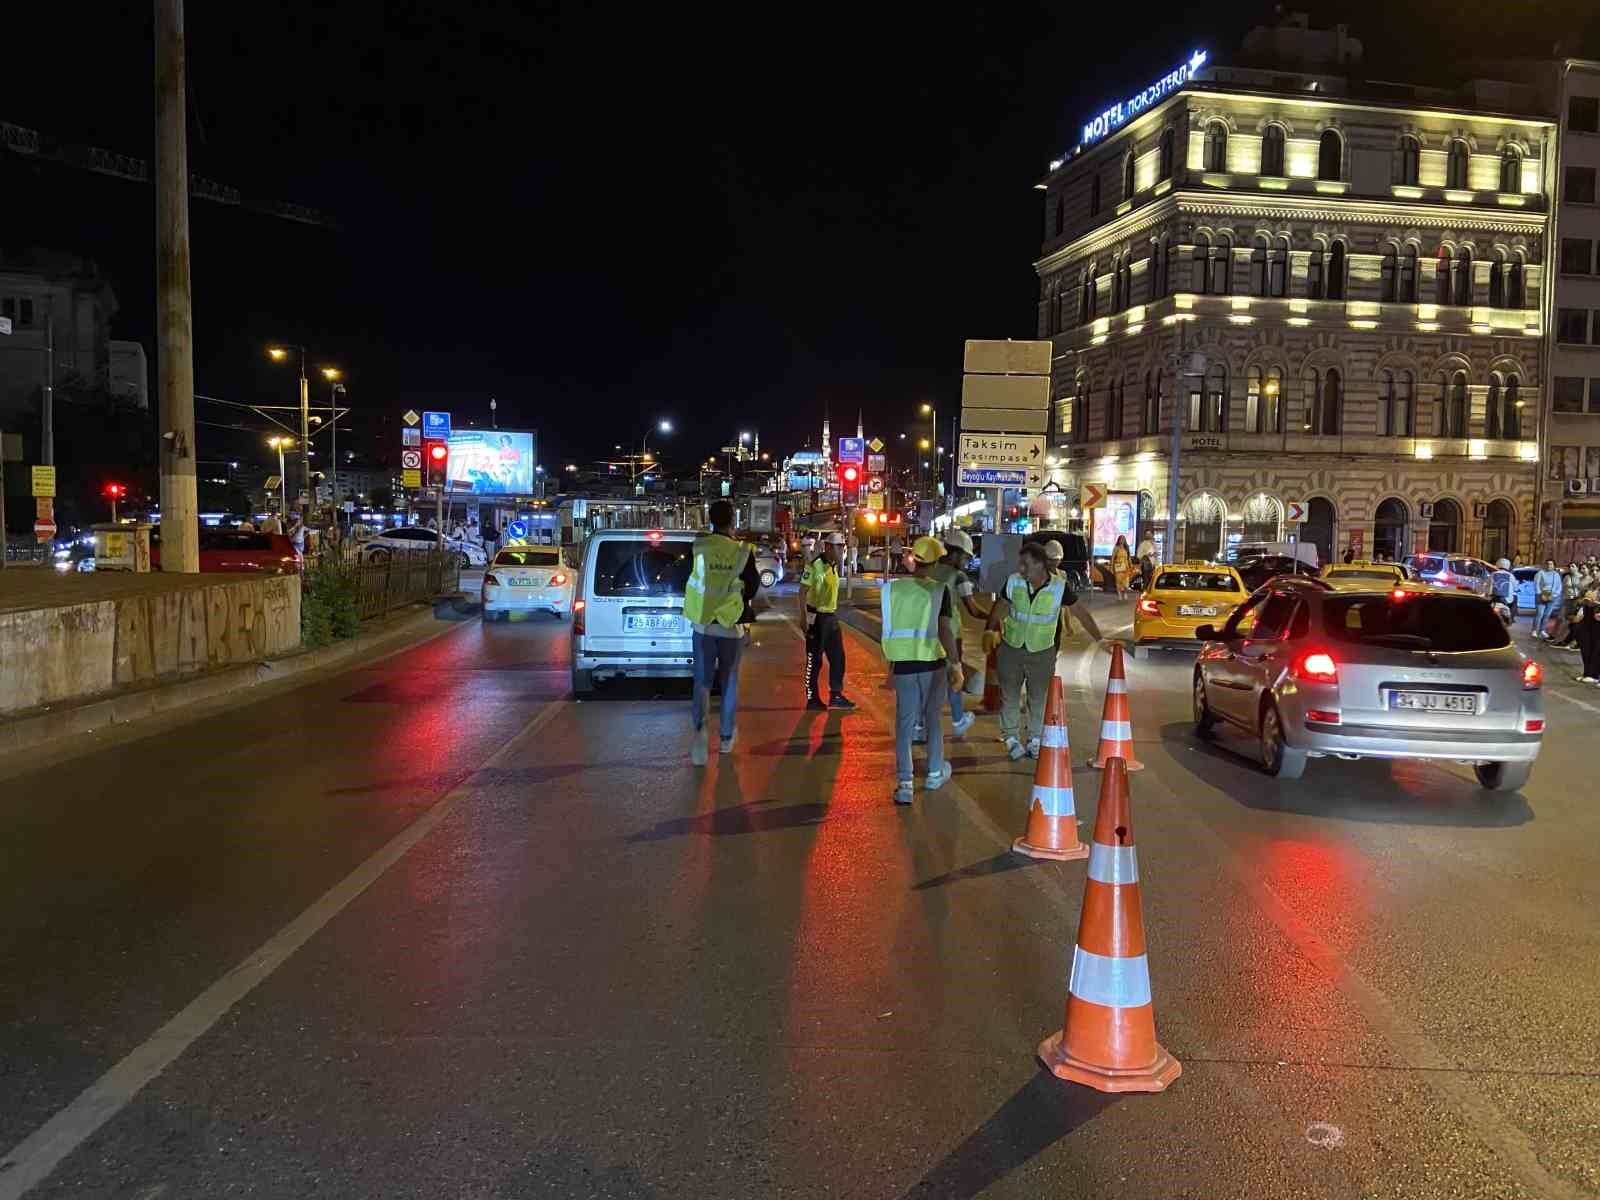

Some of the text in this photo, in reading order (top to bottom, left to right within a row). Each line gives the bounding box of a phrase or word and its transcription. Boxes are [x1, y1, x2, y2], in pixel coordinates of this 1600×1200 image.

[1084, 102, 1124, 142] HOTEL
[965, 438, 1017, 450] Taksim
[1192, 438, 1222, 446] HOTEL
